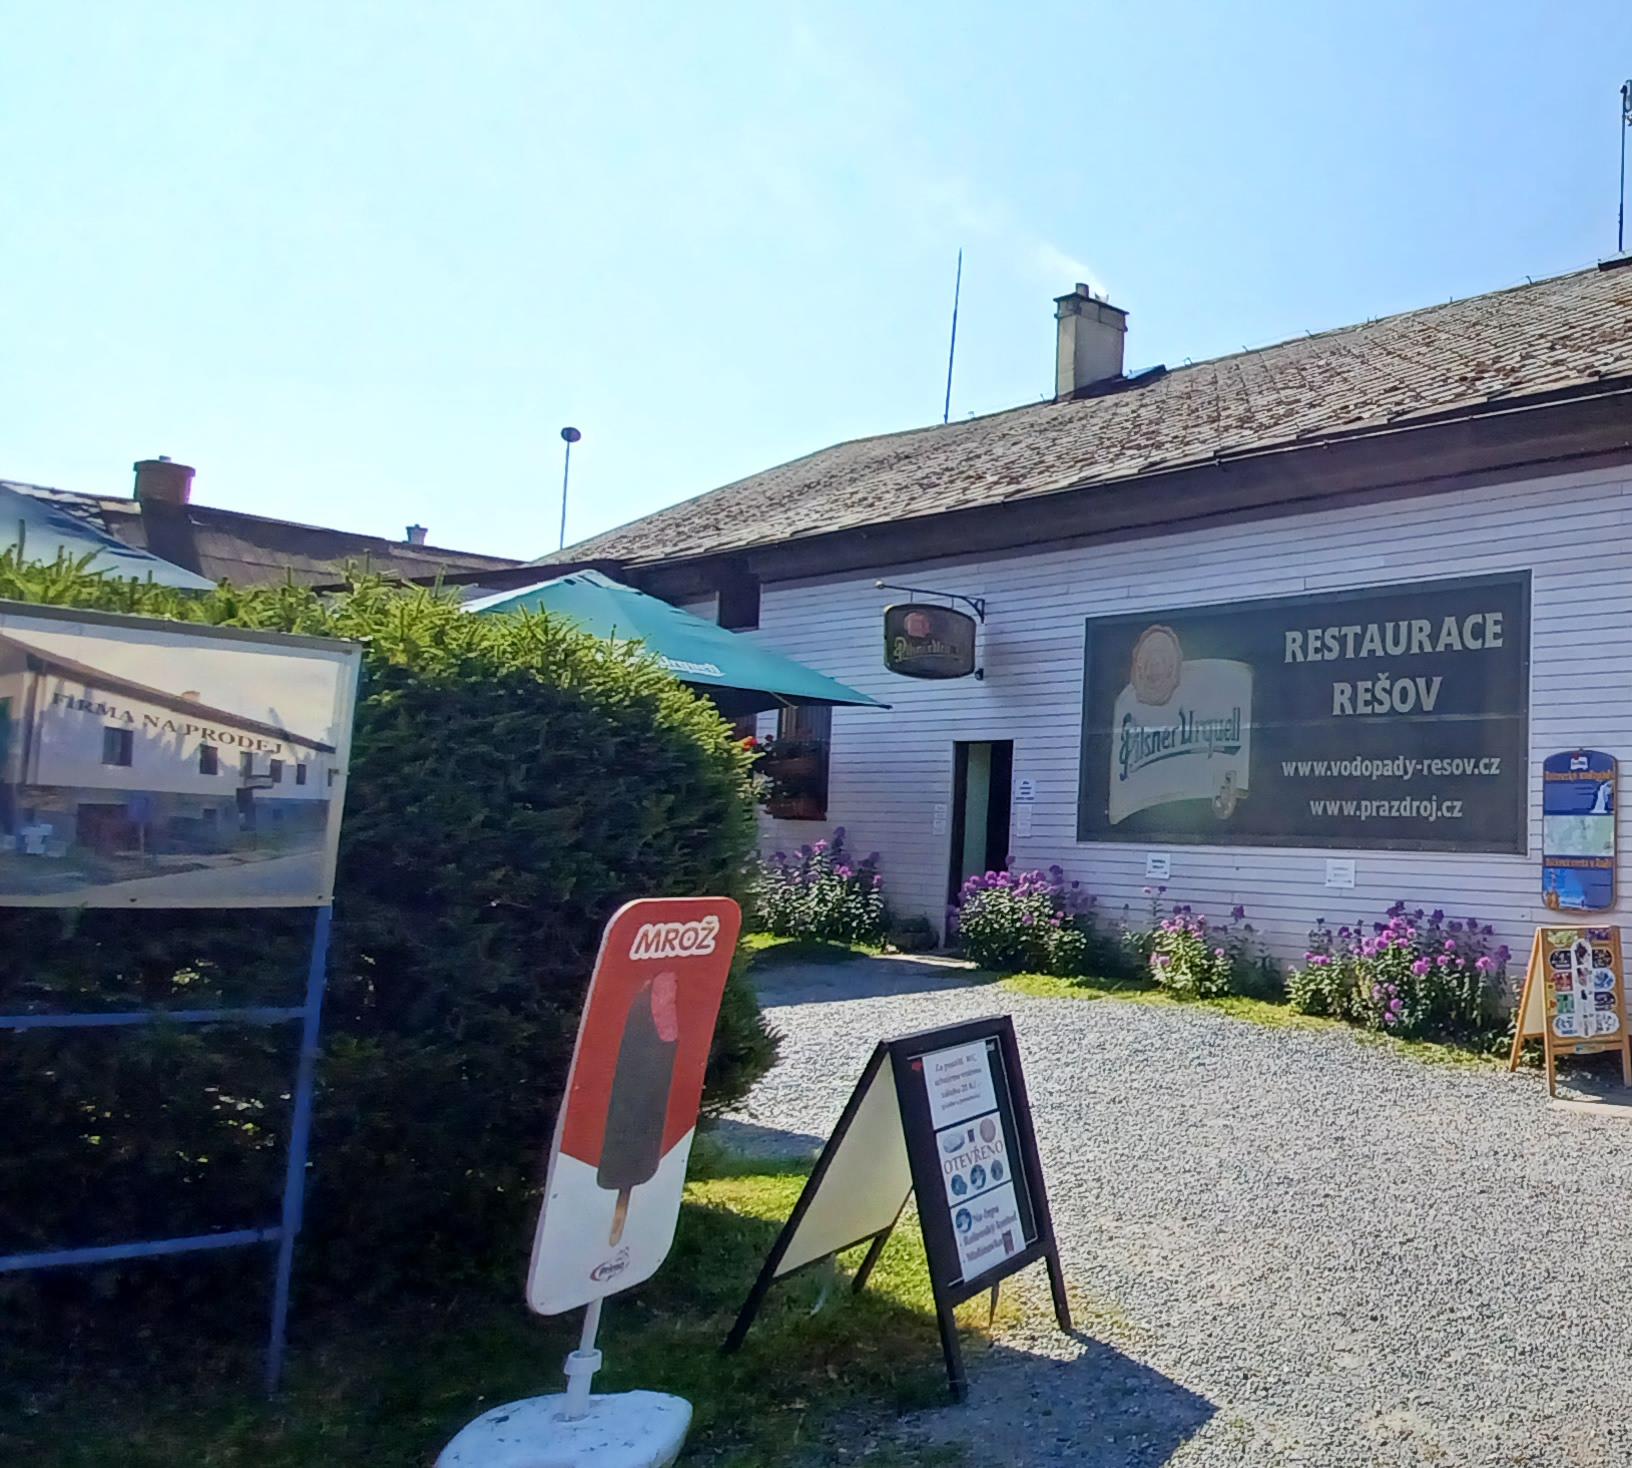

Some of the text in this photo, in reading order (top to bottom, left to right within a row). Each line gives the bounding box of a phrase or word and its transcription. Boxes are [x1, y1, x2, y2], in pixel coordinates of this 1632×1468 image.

[1284, 612, 1504, 663] RESTAURACE
[1332, 672, 1444, 716] REŠOV
[53, 692, 283, 754] FIRMA NA PRODEJ
[1119, 705, 1241, 781] Pilsner Urquell
[1282, 755, 1502, 780] www.vodopady-resov.cz
[1310, 795, 1464, 821] www.prazdroj.cz
[632, 918, 717, 957] MROŽ
[943, 1139, 1004, 1175] OTEVŘENO
